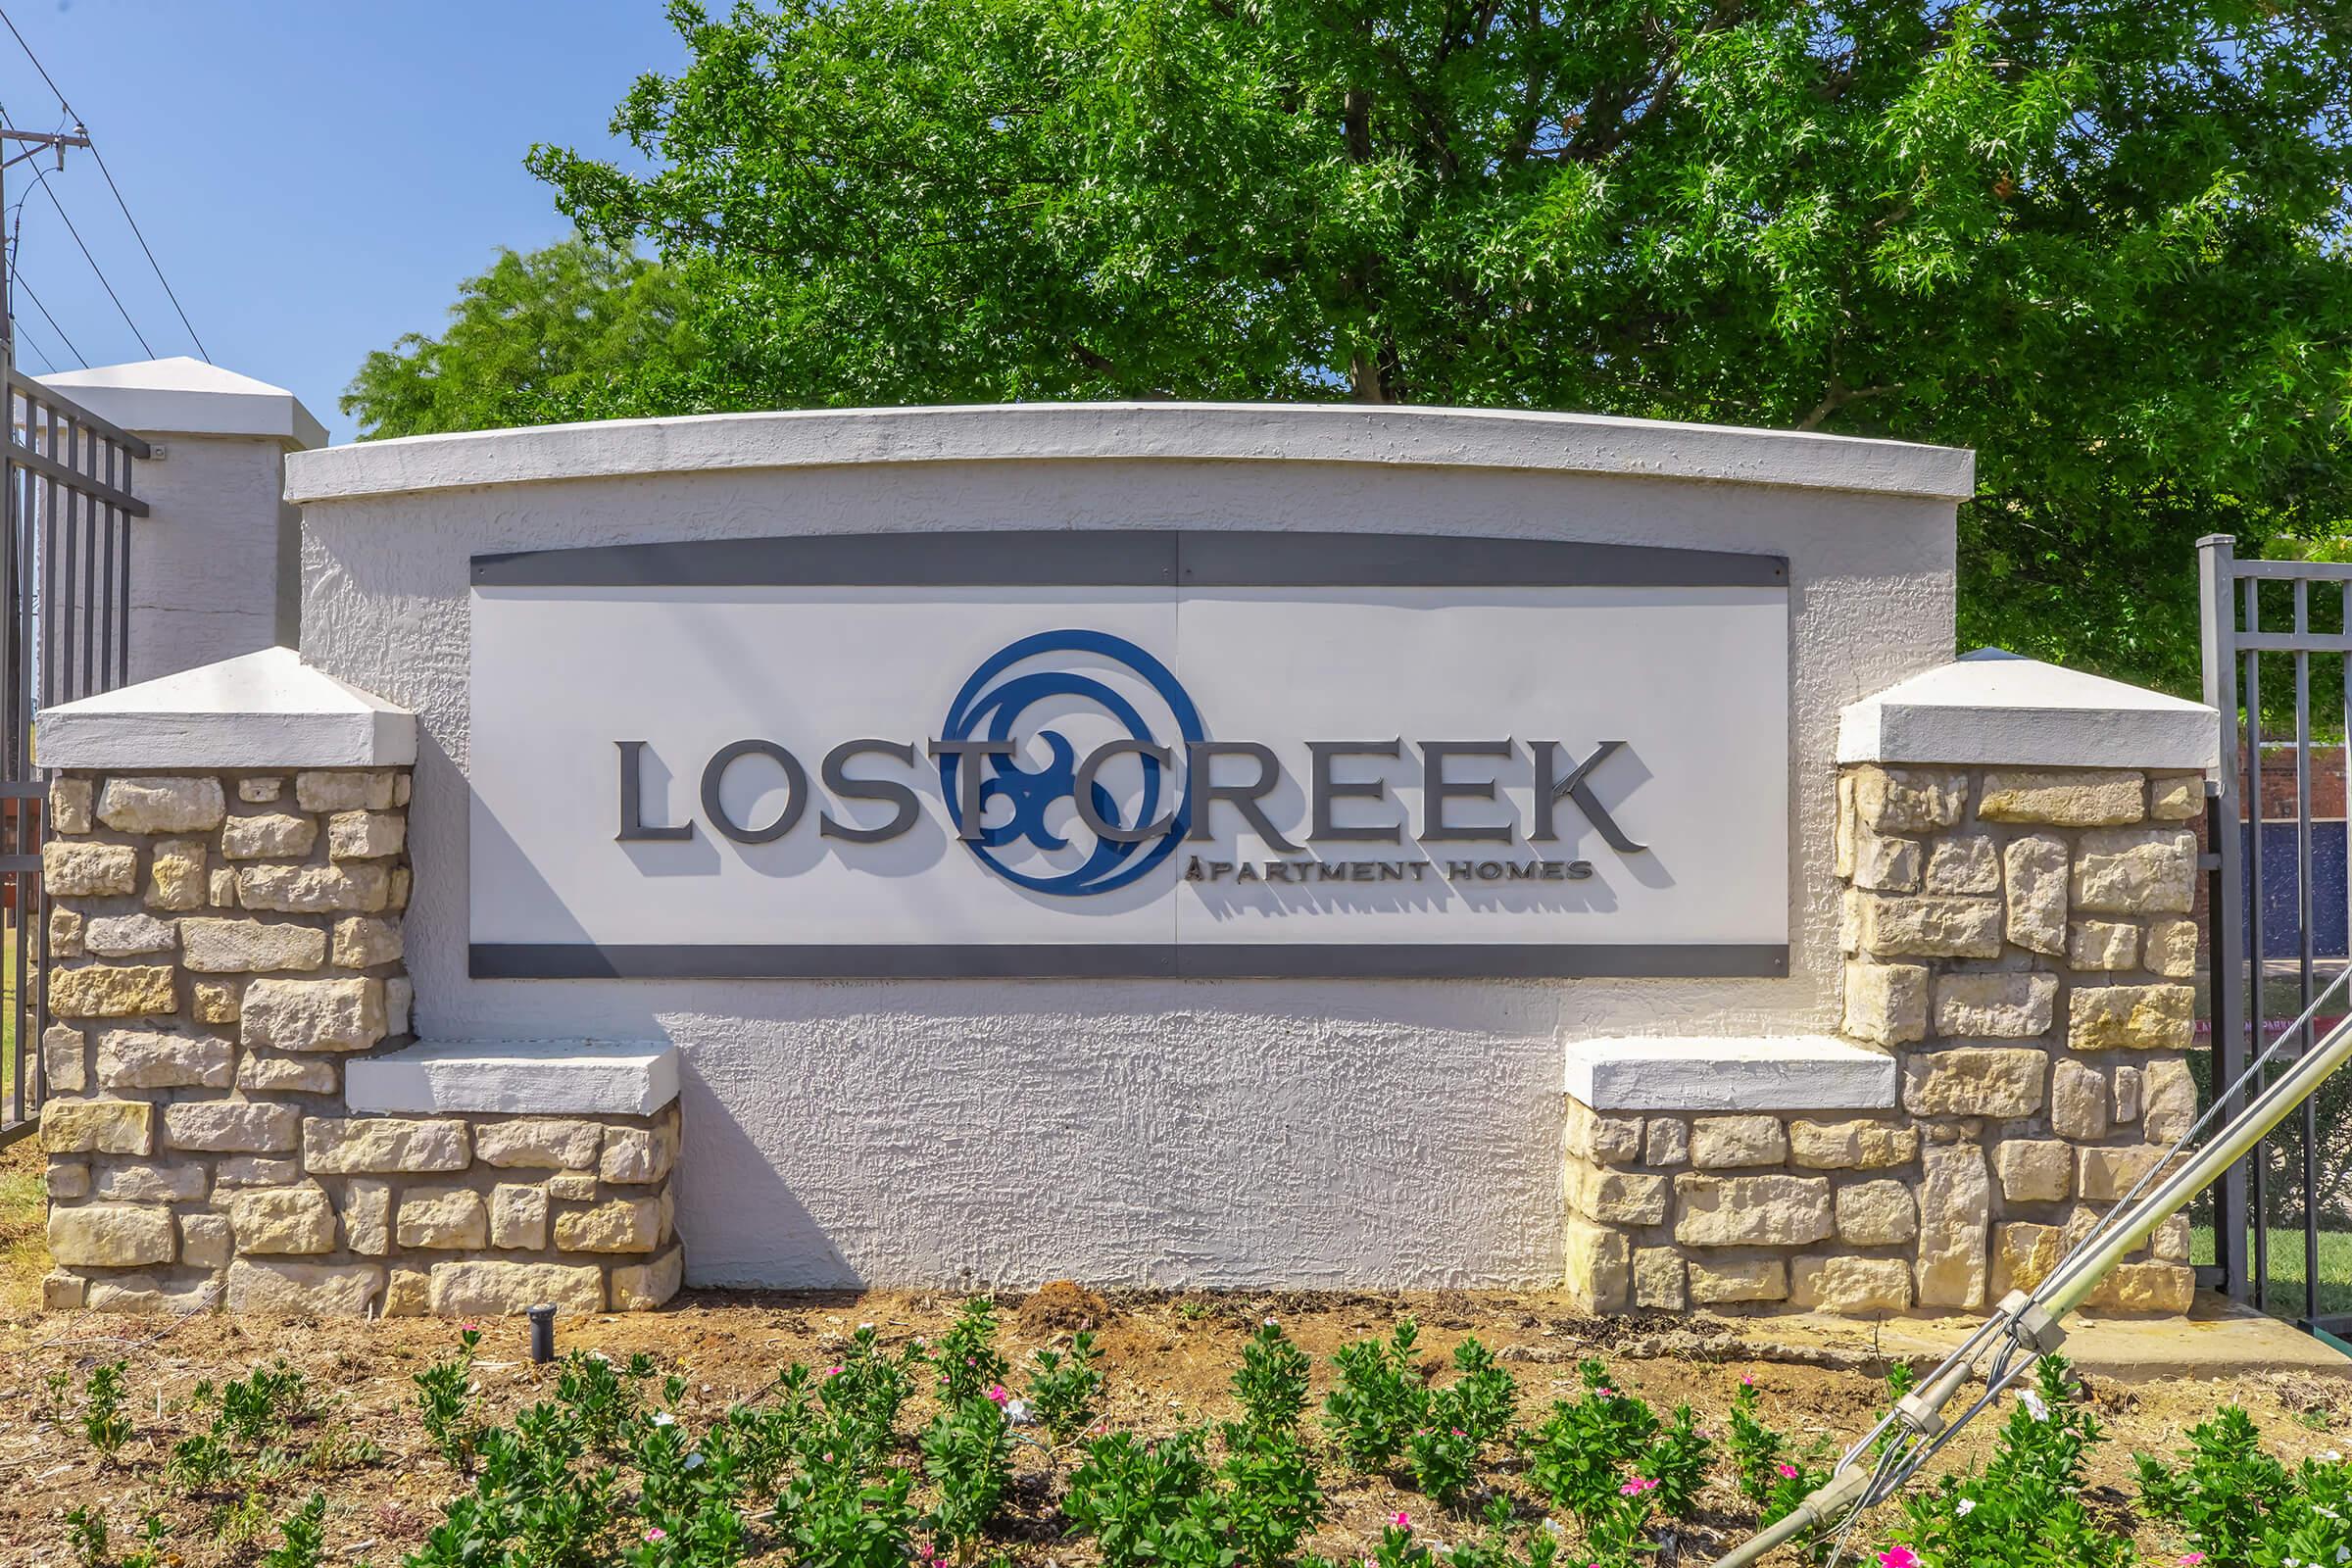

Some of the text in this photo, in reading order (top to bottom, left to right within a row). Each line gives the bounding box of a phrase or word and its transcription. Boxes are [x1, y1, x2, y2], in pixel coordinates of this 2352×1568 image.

[613, 733, 1648, 853] LOST CREEK
[1184, 855, 1593, 884] APARTMENT HOMES
